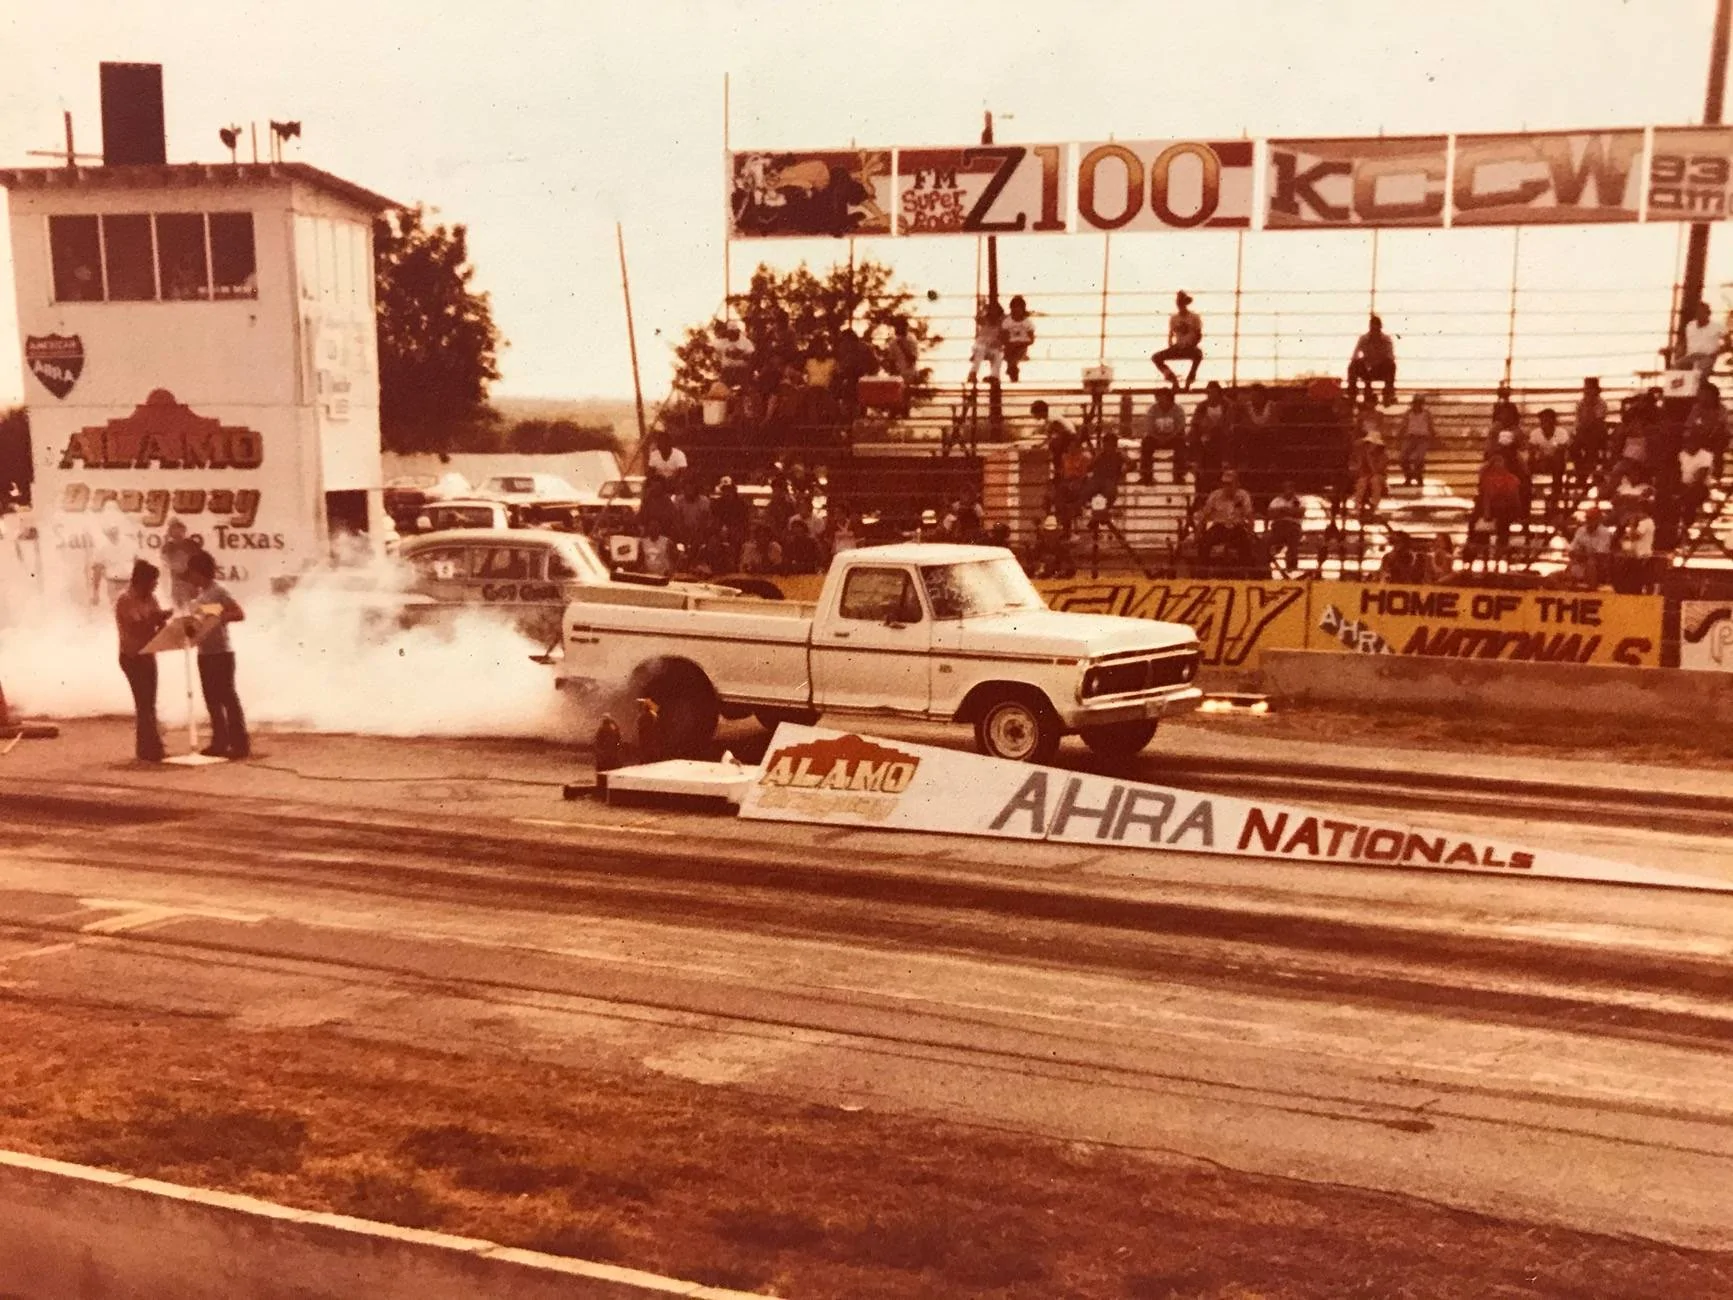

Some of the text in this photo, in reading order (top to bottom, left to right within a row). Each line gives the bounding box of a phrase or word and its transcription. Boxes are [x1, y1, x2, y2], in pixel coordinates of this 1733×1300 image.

[914, 167, 958, 190] FM
[963, 142, 1221, 231] Z100
[1270, 134, 1640, 221] KCCW
[901, 189, 967, 213] Super
[59, 430, 264, 470] ALAMO
[62, 483, 262, 528] Dragway
[214, 525, 286, 550] Texas
[1360, 588, 1603, 626] HOME OF THE
[758, 755, 917, 794] ALAMO
[989, 770, 1535, 871] AHRA NATIONALS
